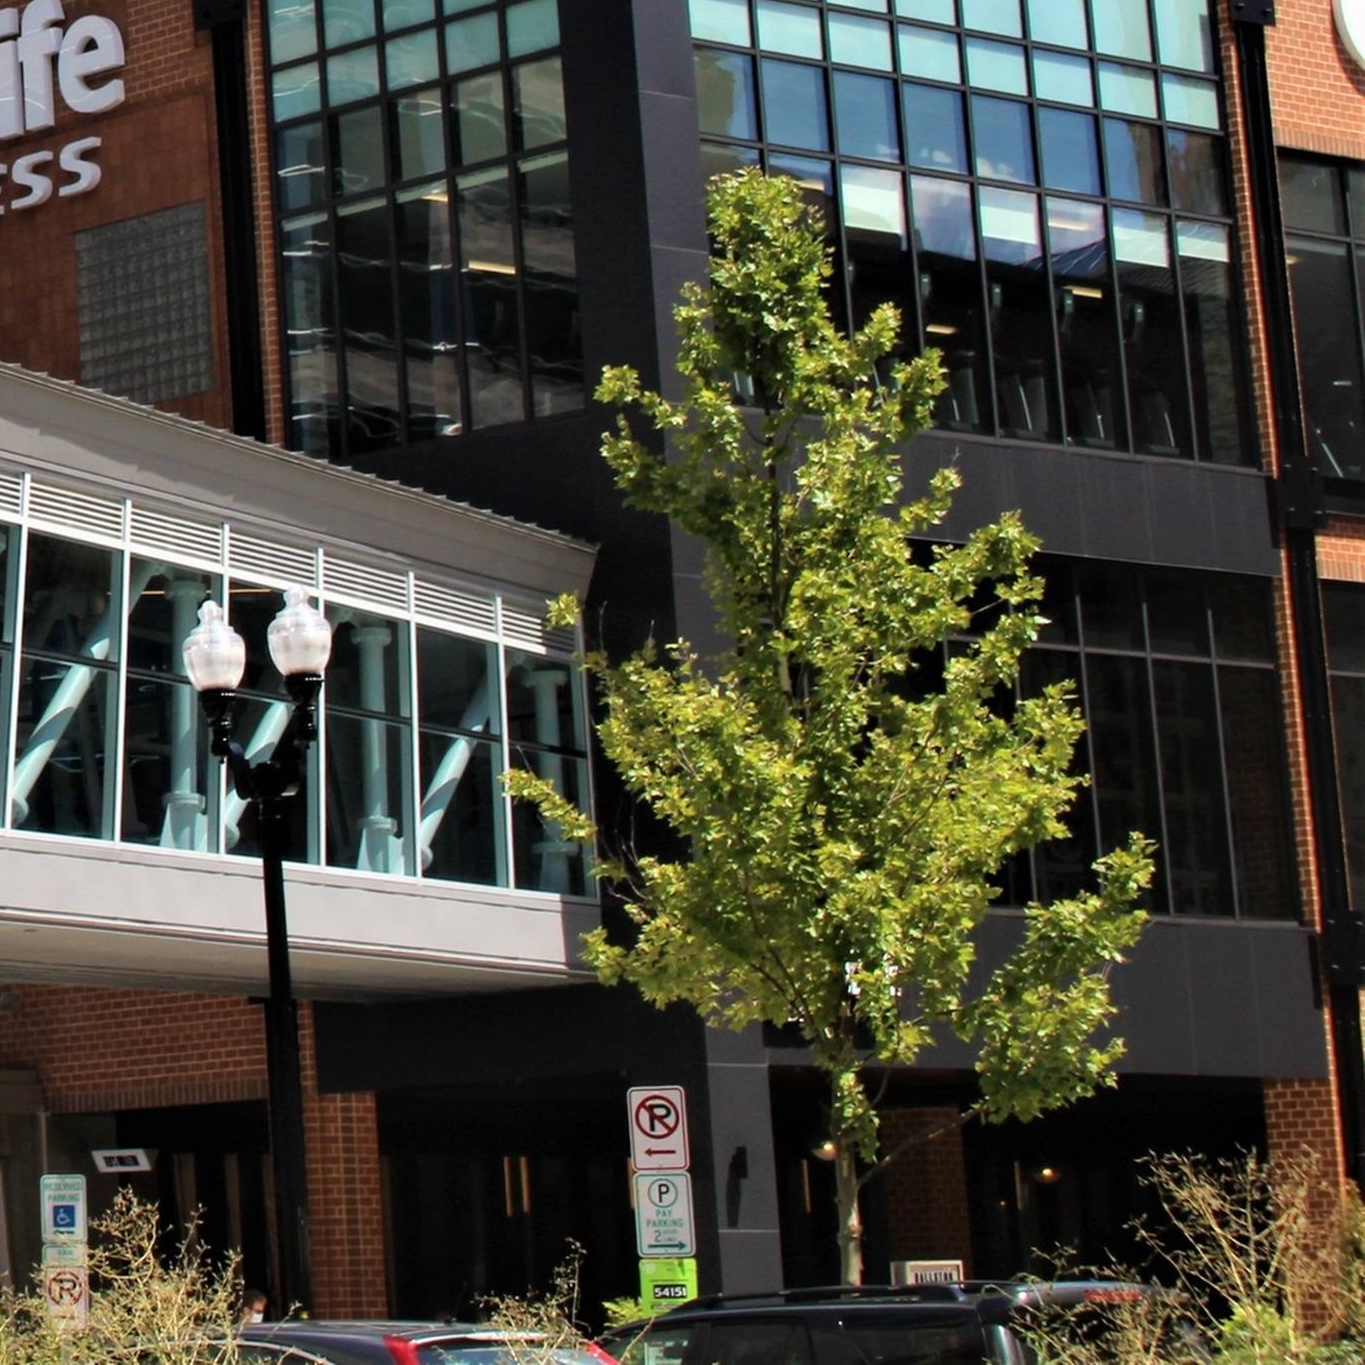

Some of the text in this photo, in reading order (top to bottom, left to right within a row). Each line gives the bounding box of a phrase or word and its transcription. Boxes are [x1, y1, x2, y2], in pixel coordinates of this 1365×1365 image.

[656, 1209, 672, 1218] PAY
[646, 1218, 684, 1228] PARKING
[654, 1286, 687, 1298] 54151
